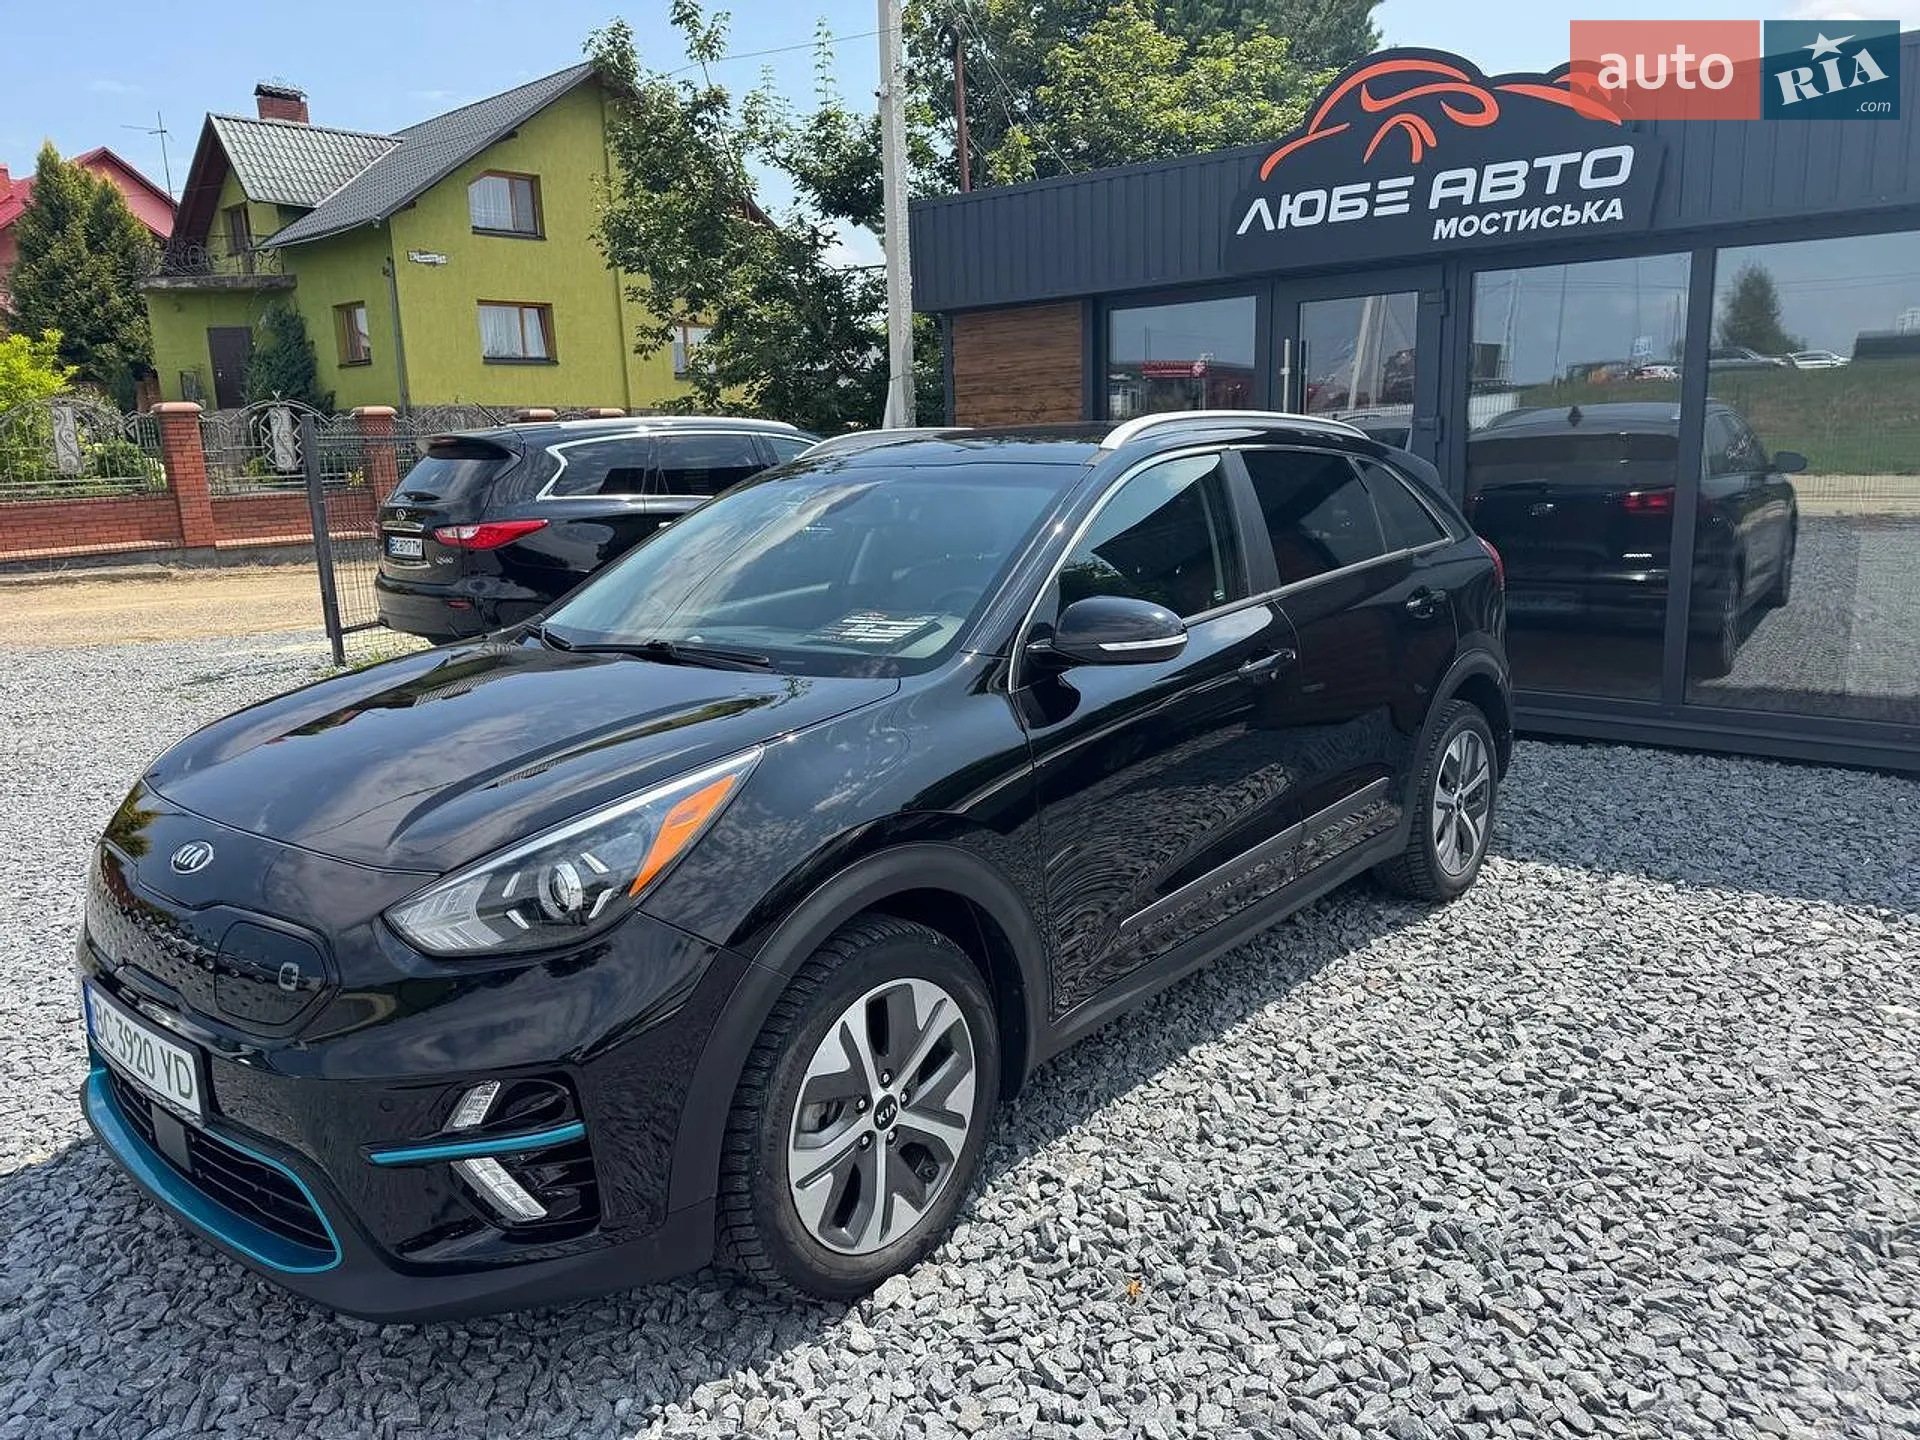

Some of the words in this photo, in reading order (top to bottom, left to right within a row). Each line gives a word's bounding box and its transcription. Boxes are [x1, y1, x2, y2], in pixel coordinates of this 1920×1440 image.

[1236, 176, 1416, 235] ЛЮБЕ
[1428, 145, 1635, 210] АВТО
[1432, 197, 1624, 241] МОСТИСЬКА
[115, 1016, 156, 1081] 3920
[159, 1045, 193, 1100] YD
[876, 1101, 898, 1125] KIA
